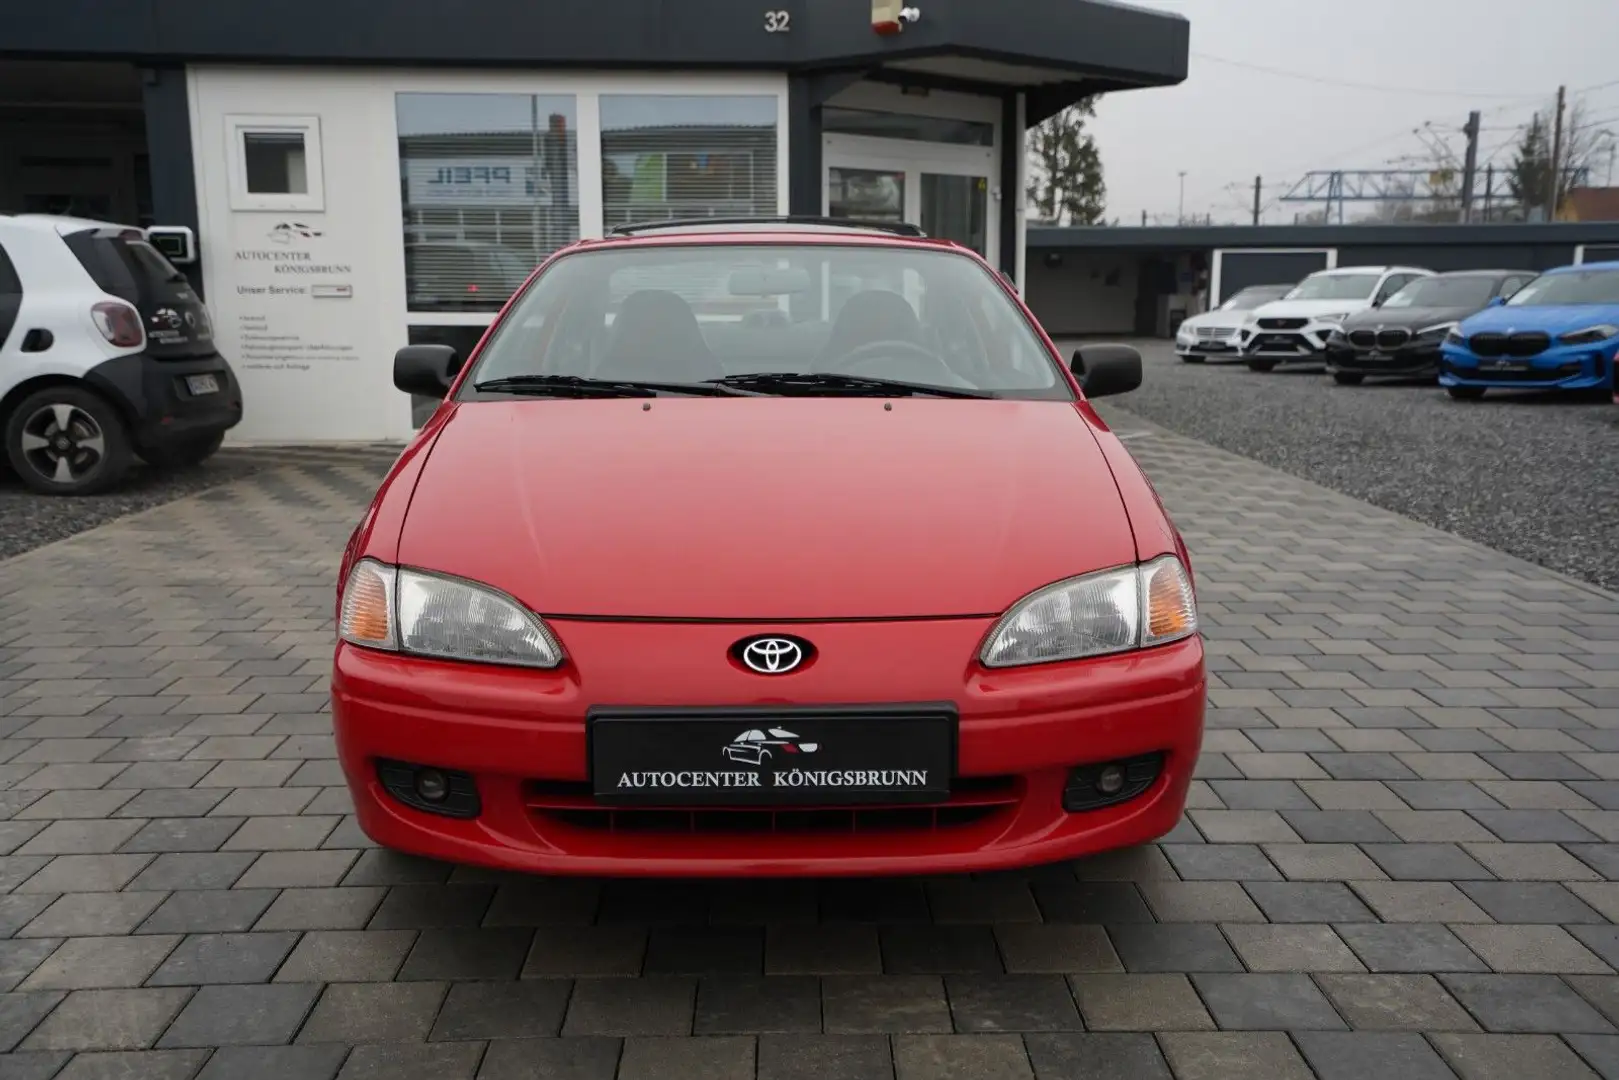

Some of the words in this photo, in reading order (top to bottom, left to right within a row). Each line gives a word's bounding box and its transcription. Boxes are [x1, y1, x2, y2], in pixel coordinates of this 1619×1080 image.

[764, 11, 790, 32] 32
[235, 250, 311, 260] AUTOCENTER
[274, 263, 352, 274] KÖNIGSBRUNN
[236, 286, 265, 295] Unser
[617, 771, 762, 788] AUTOCENTER
[773, 768, 928, 787] KÖNIGSBRUNN
